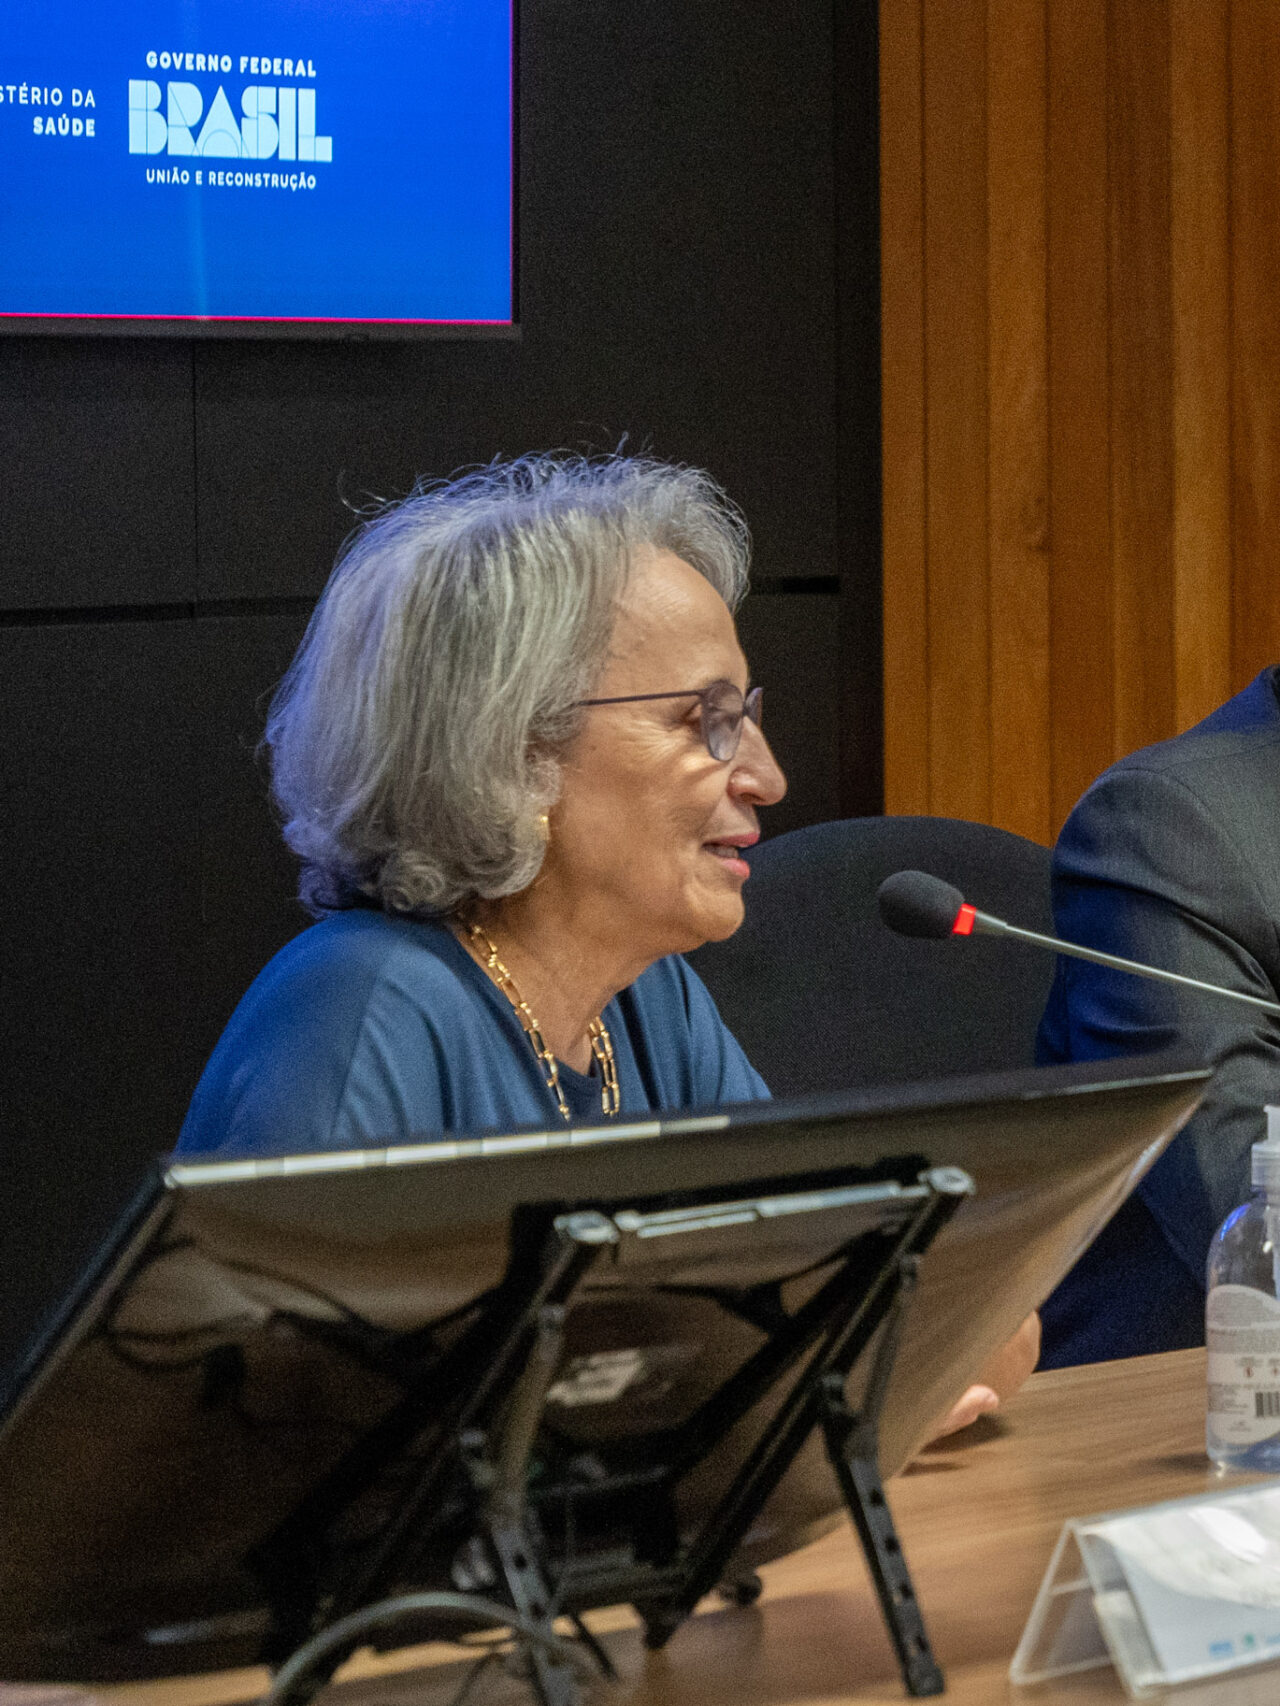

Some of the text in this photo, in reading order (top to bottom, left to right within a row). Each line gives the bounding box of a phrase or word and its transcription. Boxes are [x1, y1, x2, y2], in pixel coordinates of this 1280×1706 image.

[146, 50, 317, 78] GOVERNO FEDERAL
[71, 88, 96, 108] DA
[33, 113, 96, 137] SAÚDE
[128, 79, 333, 163] BRASIL
[146, 166, 317, 192] UNIÃO E RECONSTRUÇÃO
